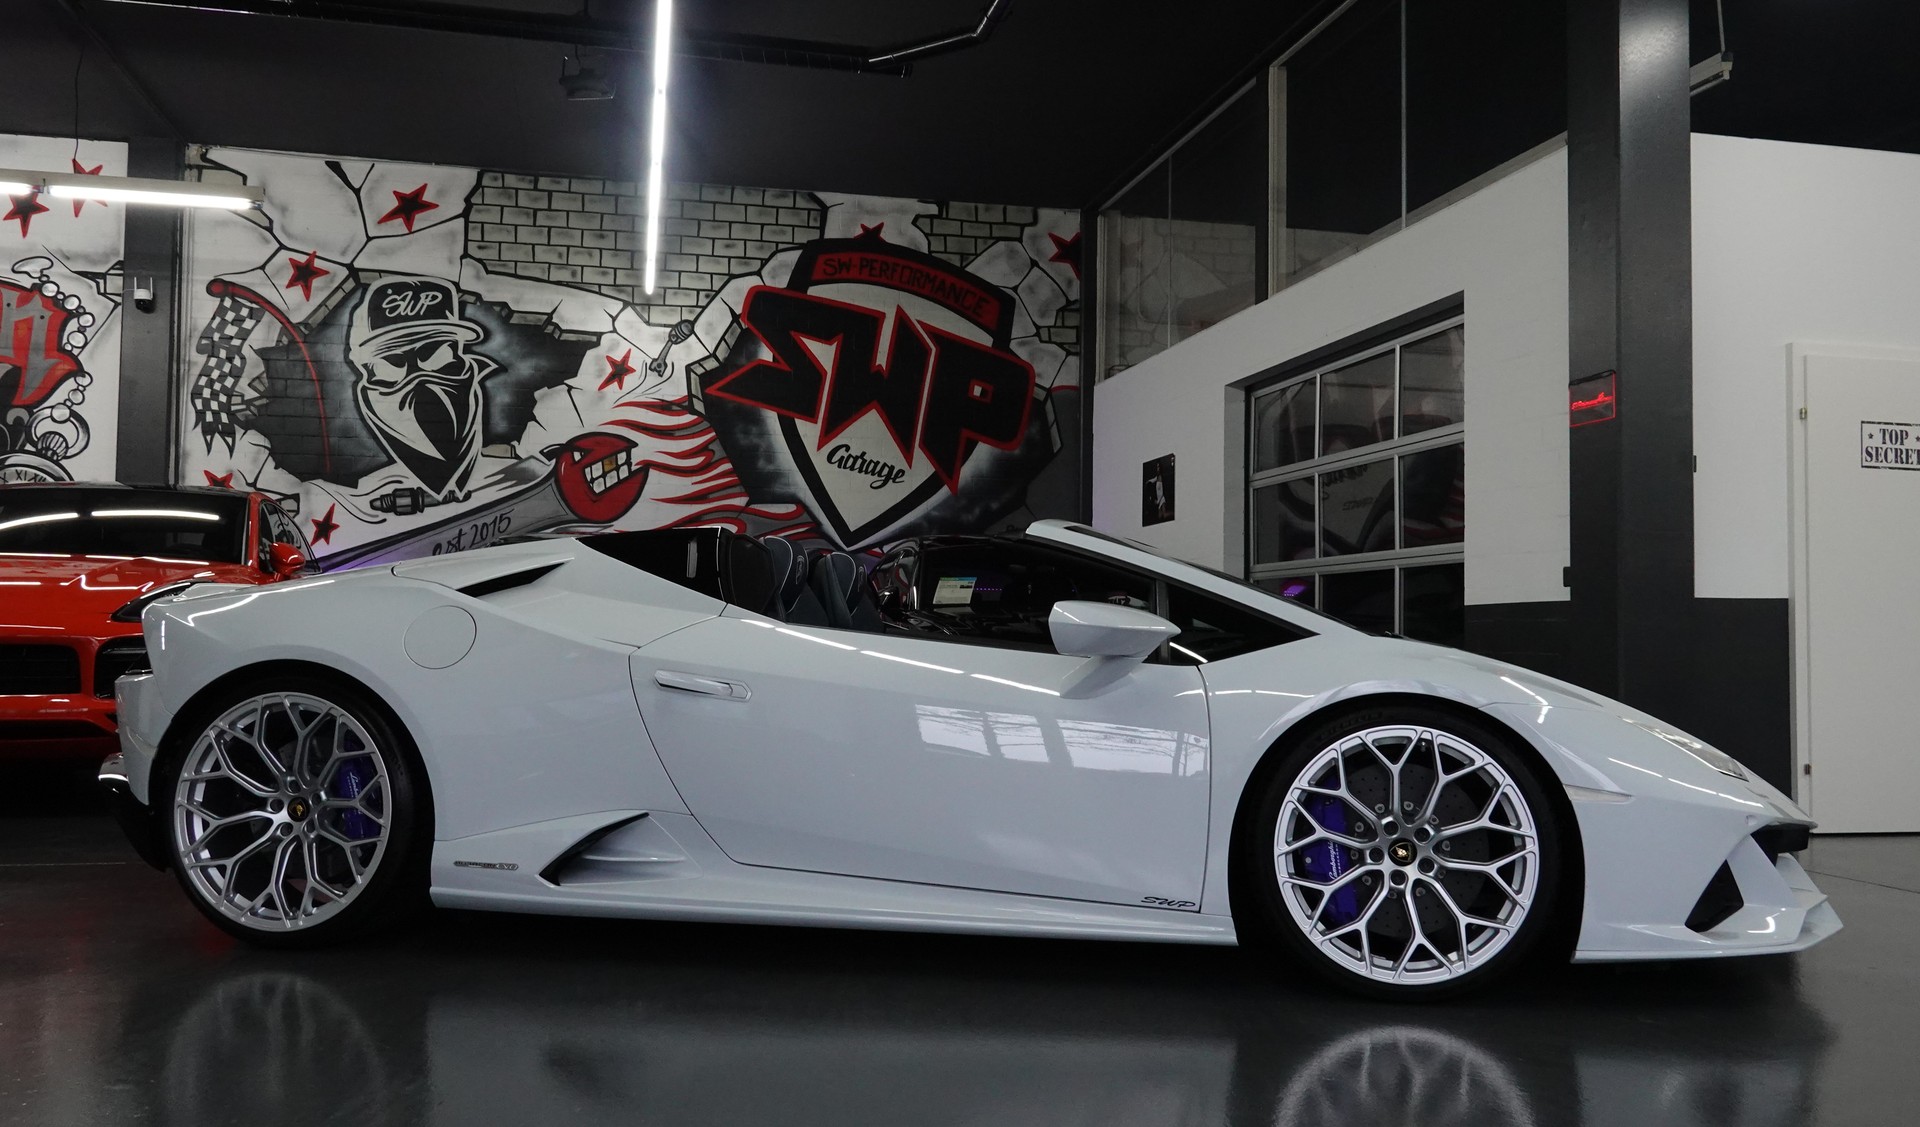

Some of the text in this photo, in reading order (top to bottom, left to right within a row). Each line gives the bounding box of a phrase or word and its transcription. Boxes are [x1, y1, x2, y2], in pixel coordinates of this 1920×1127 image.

[382, 290, 443, 317] SWP
[705, 285, 1035, 496] SWP
[1879, 428, 1909, 446] TOP
[826, 443, 906, 490] Garage
[469, 508, 515, 548] 2015
[1140, 896, 1196, 908] SWP
